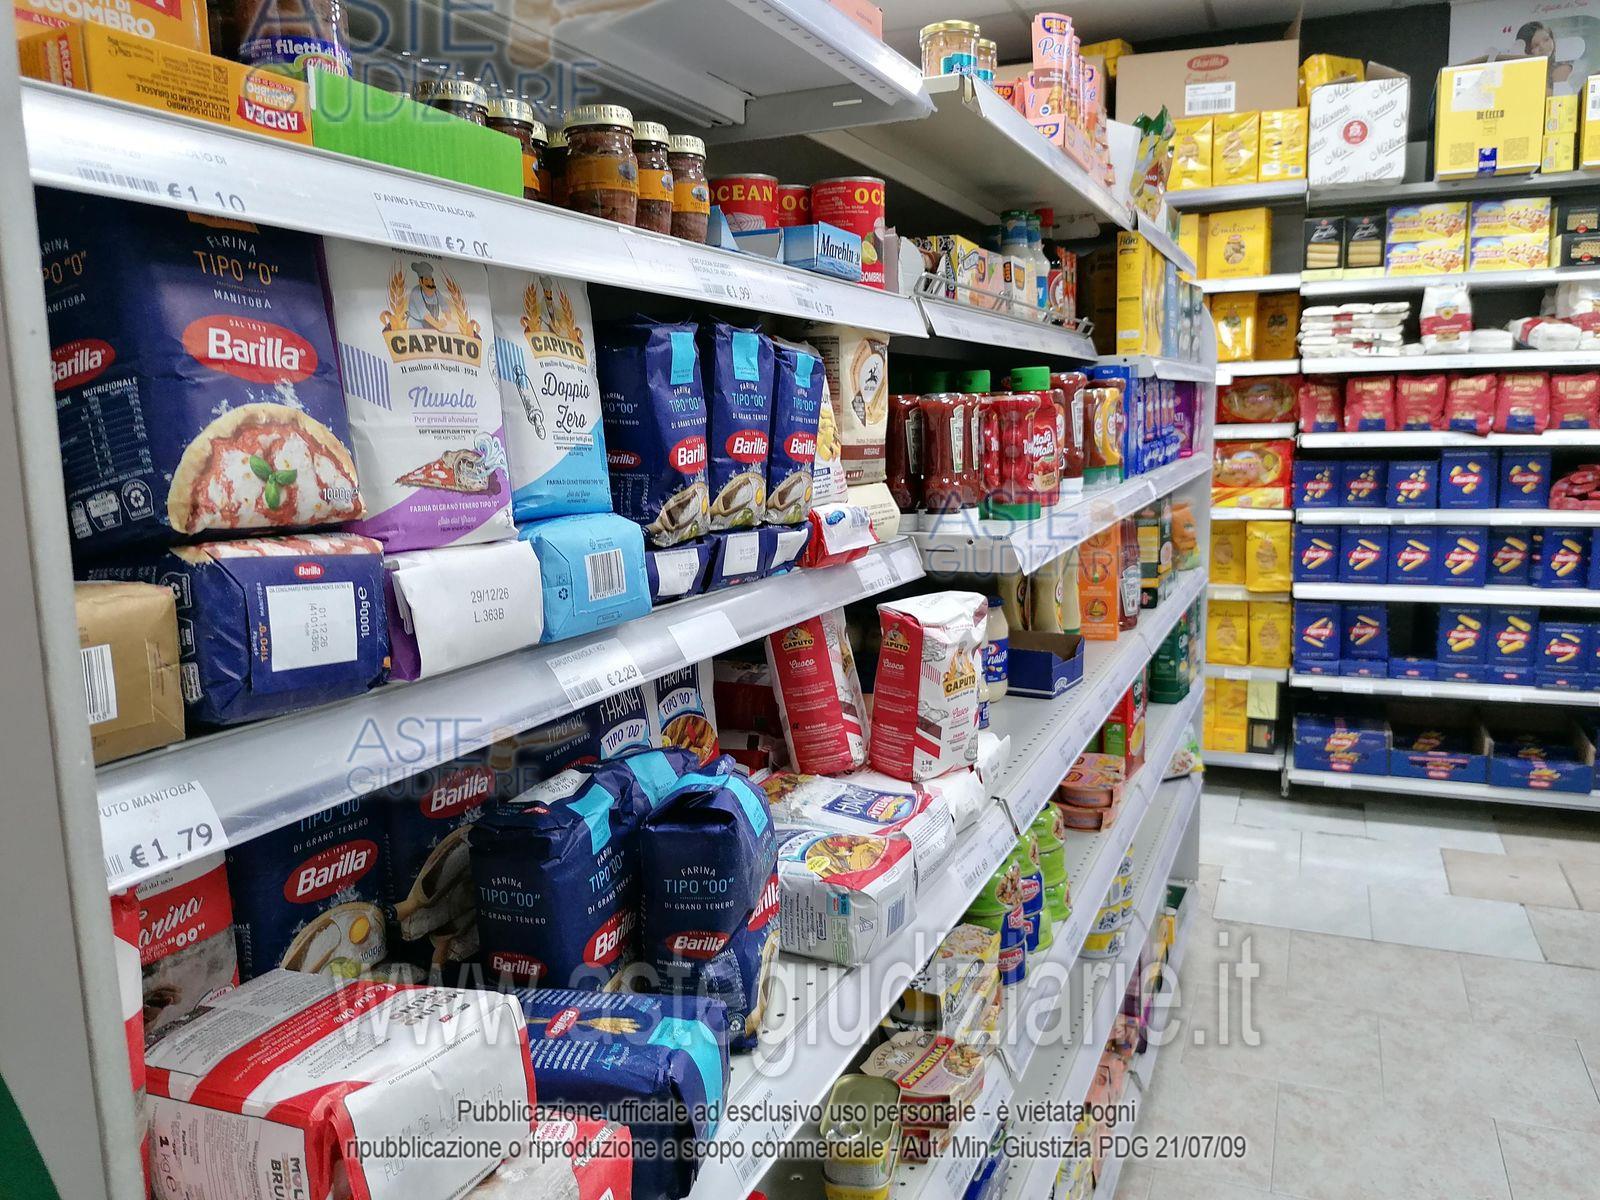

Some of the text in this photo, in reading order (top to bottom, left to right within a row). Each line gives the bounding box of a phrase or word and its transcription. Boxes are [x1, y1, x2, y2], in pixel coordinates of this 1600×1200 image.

[244, 100, 299, 130] ARDEA
[206, 234, 257, 255] FARINA
[821, 232, 855, 263] Mareblu
[193, 250, 244, 282] TIPO
[213, 288, 272, 310] MANITOBA
[207, 327, 300, 372] Barilla
[390, 334, 480, 360] CAPUTO
[531, 335, 585, 360] CAPUTO
[408, 363, 432, 373] mulino
[433, 362, 440, 371] di
[440, 363, 460, 373] Napoli
[463, 367, 478, 377] 1924
[407, 385, 477, 409] Nuvola
[541, 372, 590, 403] Doppio
[669, 399, 686, 413] TIPO
[732, 392, 750, 406] TIPO
[556, 404, 588, 434] Zero
[732, 437, 767, 455] Barilla
[409, 504, 432, 513] FARINA
[298, 564, 322, 577] Barilla
[470, 587, 510, 604] 29/12/26
[783, 638, 813, 650] CAPUTO
[945, 675, 976, 693] CAPUTO
[663, 695, 678, 715] TIPO
[605, 731, 624, 750] TIPO
[131, 781, 197, 810] MANITOBA
[430, 770, 490, 812] Barilla
[306, 831, 335, 848] GRANO
[337, 818, 369, 836] TENERO
[296, 848, 368, 897] Barilla
[589, 867, 611, 893] TIPO
[680, 866, 717, 877] FARINA
[491, 876, 523, 889] FARINA
[663, 879, 700, 894] TIPO
[480, 886, 509, 905] TIPO
[597, 890, 617, 909] GRANO
[674, 902, 701, 911] GRANO
[705, 899, 735, 911] TENERO
[488, 913, 547, 925] GRANO TENERO
[593, 910, 637, 962] Barilla
[673, 935, 727, 952] Barilla
[493, 955, 540, 976] Barilla
[551, 1010, 578, 1036] Barilla
